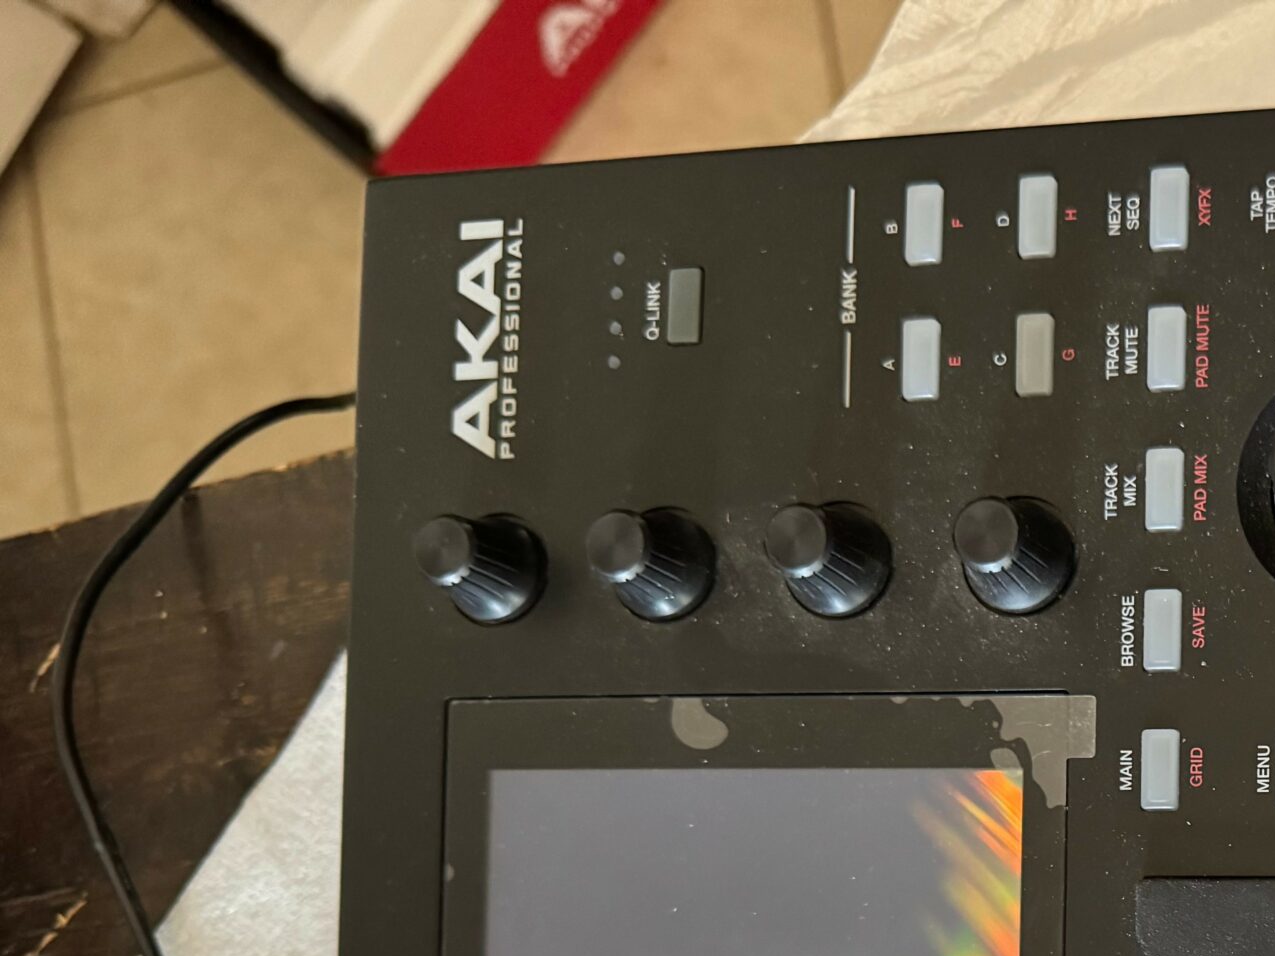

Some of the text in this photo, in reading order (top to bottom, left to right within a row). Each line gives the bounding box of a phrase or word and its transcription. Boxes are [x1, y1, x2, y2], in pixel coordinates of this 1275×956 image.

[952, 218, 963, 229] F
[997, 213, 1009, 227] D
[1065, 209, 1076, 220] H
[1108, 194, 1121, 236] NEXT
[1127, 196, 1140, 230] SEQ
[1198, 188, 1211, 226] XYFX
[1250, 190, 1263, 220] TAP
[885, 221, 898, 234] B
[645, 281, 662, 342] Q-LINK
[842, 270, 857, 324] BANK
[451, 219, 504, 459] AKAI
[498, 219, 524, 461] PROFESSIONAL
[995, 353, 1007, 365] C
[1063, 349, 1075, 360] G
[1106, 324, 1120, 379] TRACK
[1125, 327, 1138, 374] MUTE
[1196, 305, 1210, 387] PAD MUTE
[883, 359, 895, 371] A
[949, 356, 961, 366] E
[1104, 464, 1119, 520] TRACK
[1124, 476, 1136, 506] MIX
[1194, 455, 1208, 521] PAD MIX
[1121, 595, 1135, 667] BROWSE
[1192, 605, 1206, 648] SAVE
[1120, 750, 1133, 791] MAIN
[1190, 747, 1203, 787] GRID
[1257, 745, 1270, 793] MENU
